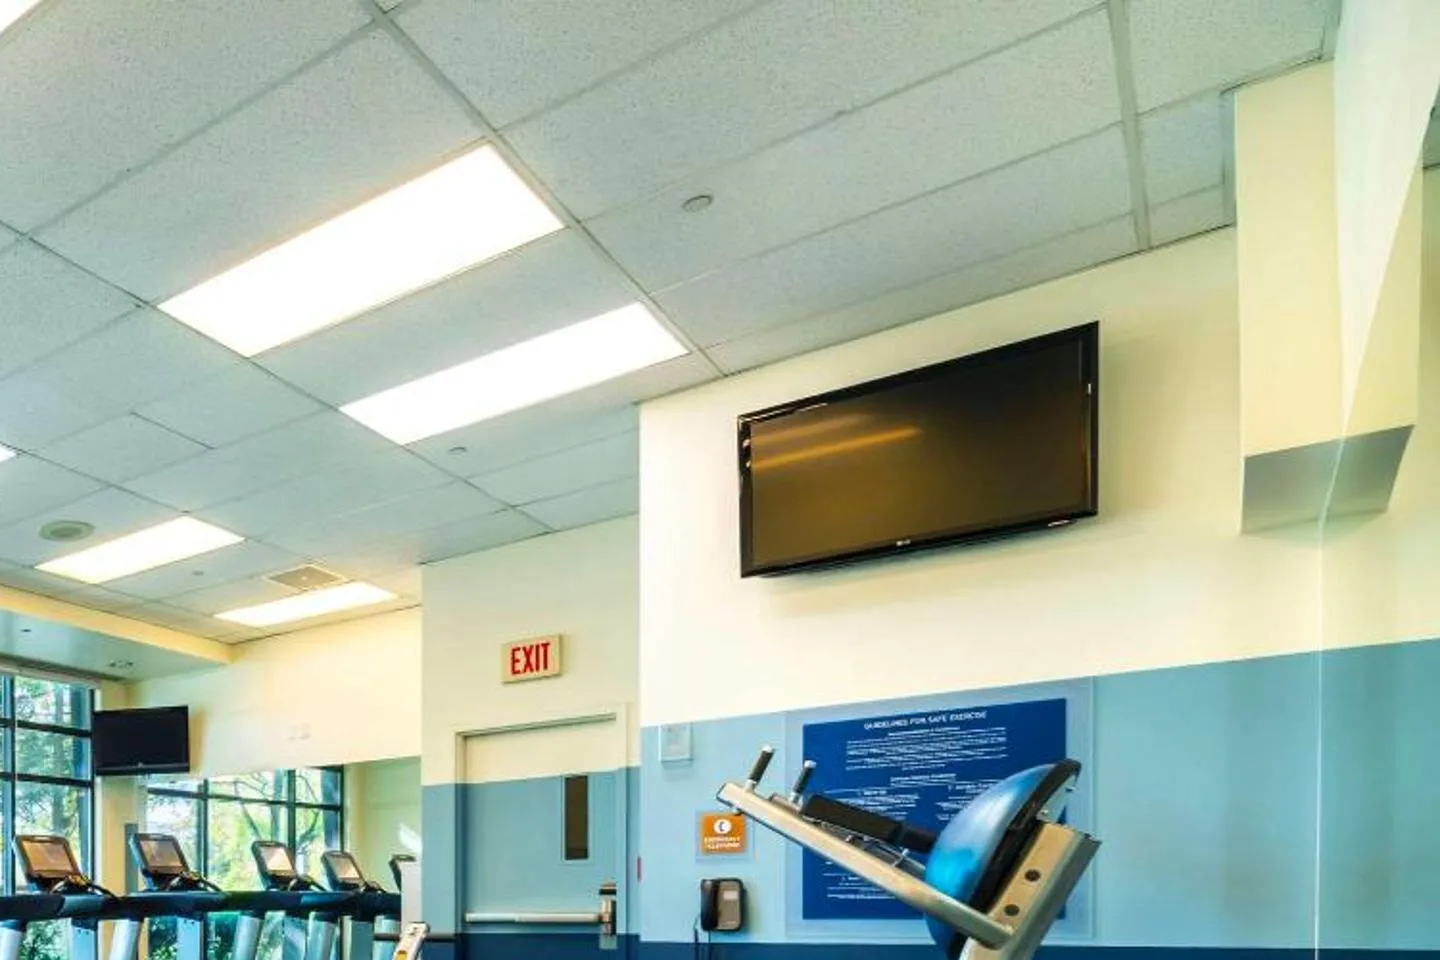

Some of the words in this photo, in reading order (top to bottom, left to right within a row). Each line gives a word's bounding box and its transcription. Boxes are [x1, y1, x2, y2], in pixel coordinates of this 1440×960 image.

[511, 642, 551, 675] EXIT
[910, 717, 926, 725] FOR
[928, 714, 947, 723] SAFE
[950, 711, 988, 721] EXERCISE
